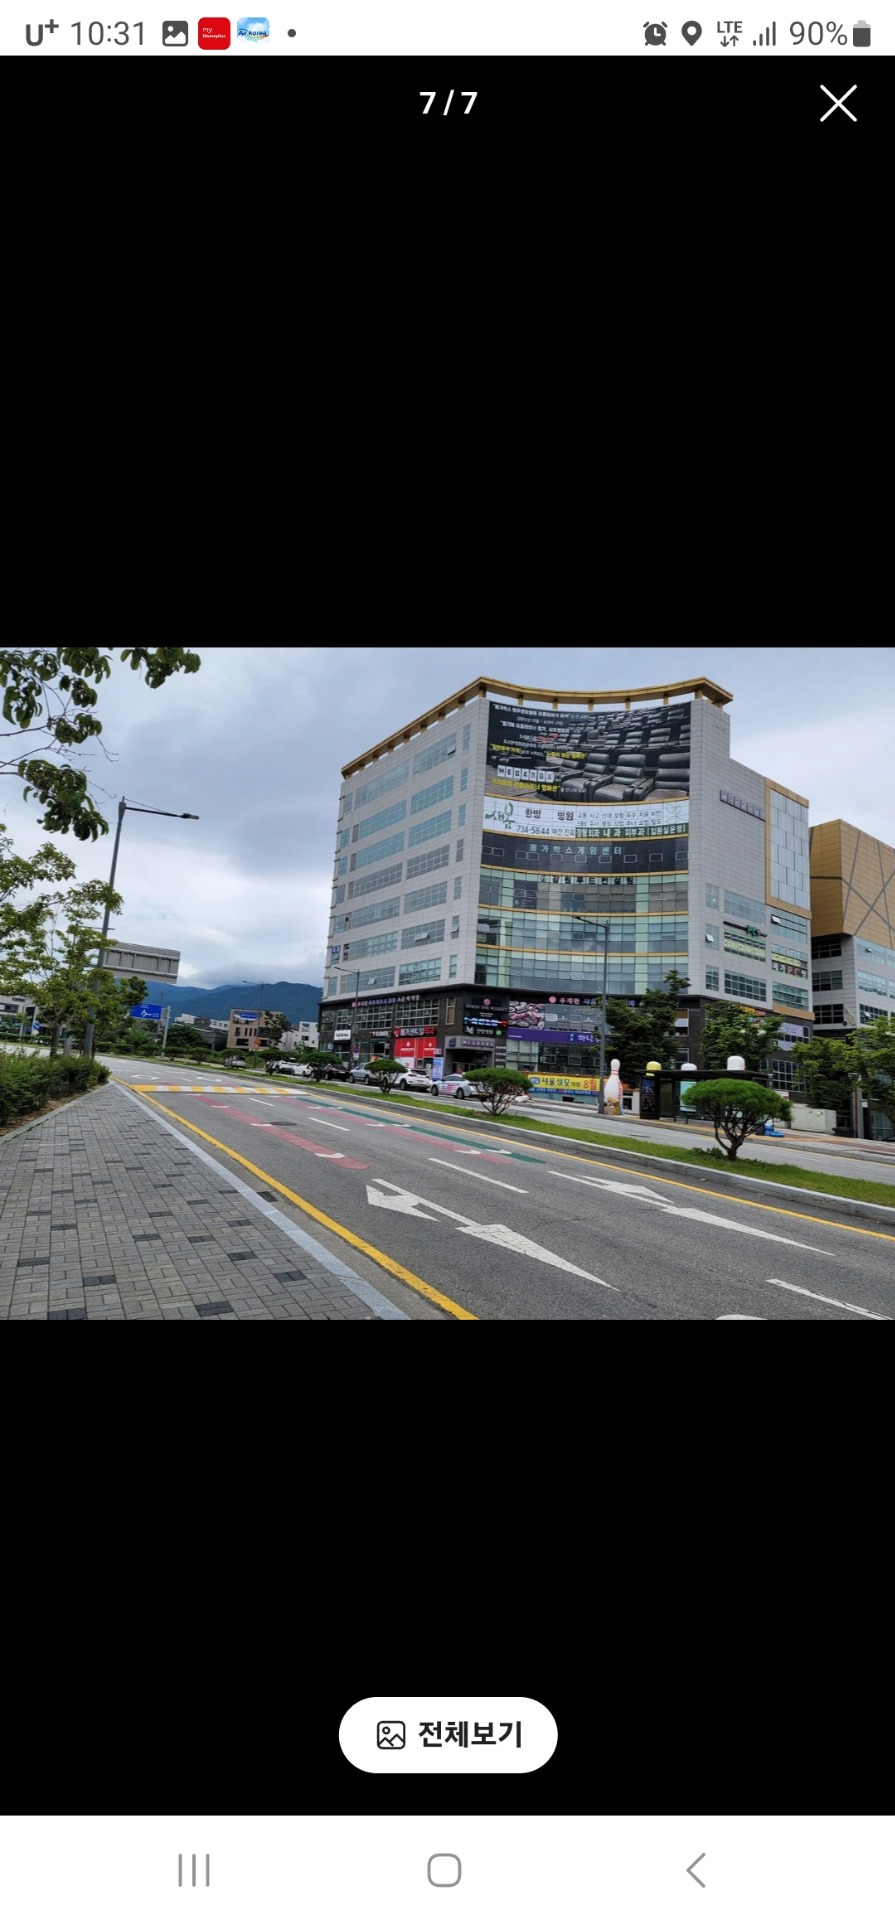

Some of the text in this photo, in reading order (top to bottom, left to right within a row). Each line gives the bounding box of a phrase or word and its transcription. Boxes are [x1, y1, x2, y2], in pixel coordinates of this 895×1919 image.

[498, 766, 553, 781] MEGABOX
[525, 808, 542, 819] 한방
[557, 811, 574, 821] 병원
[517, 825, 549, 836] 734-5844
[551, 828, 563, 836] 야간
[576, 828, 600, 838] 정형외과
[624, 827, 646, 837] 피부과
